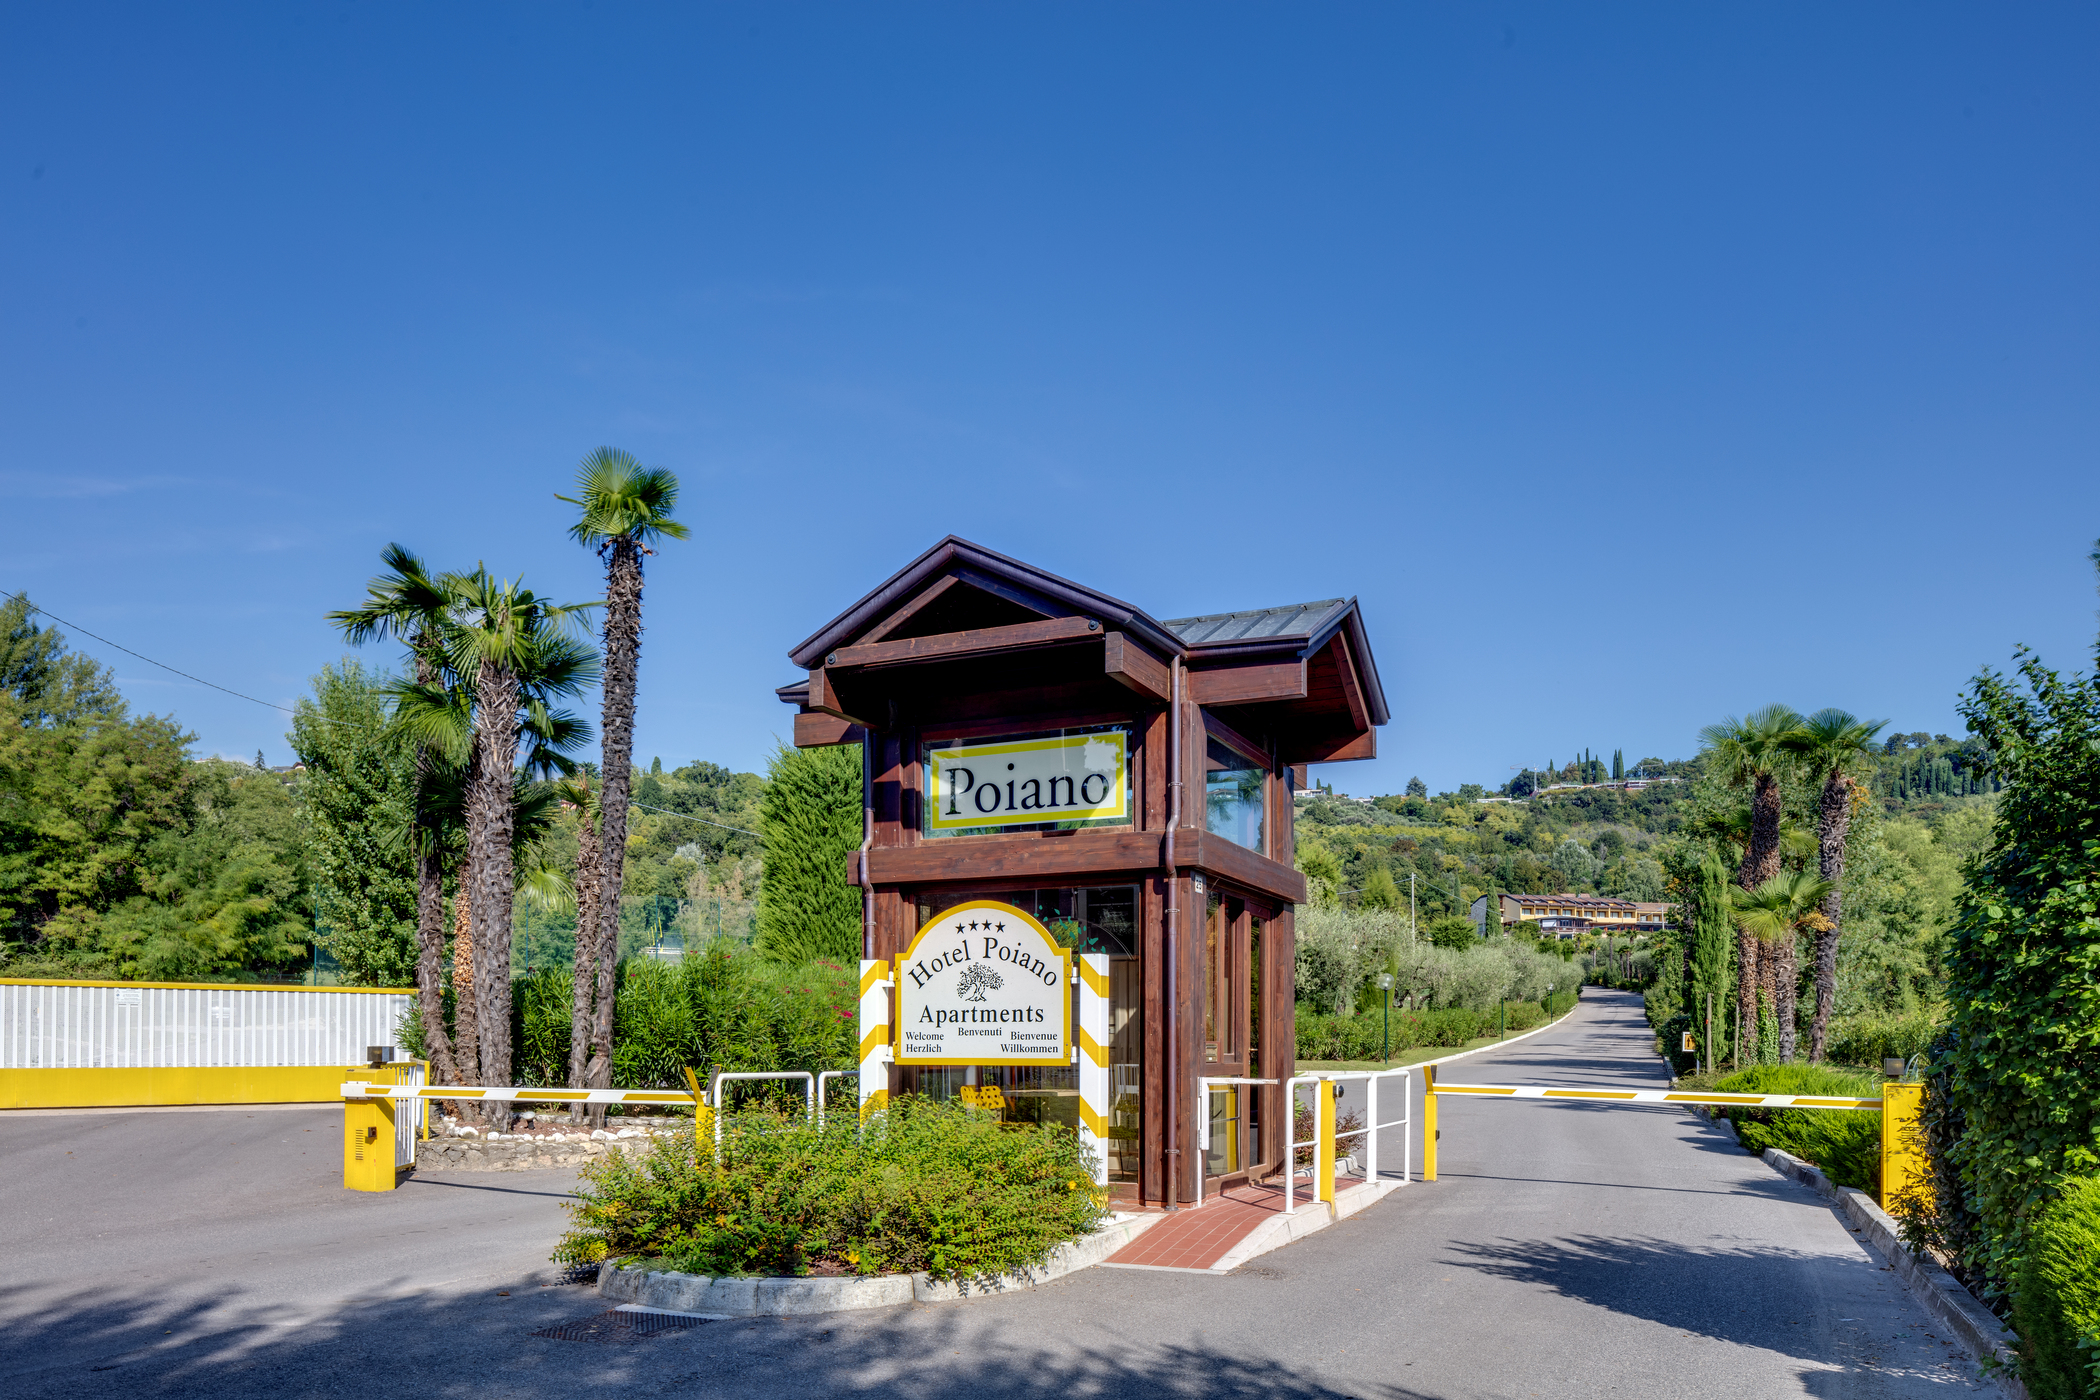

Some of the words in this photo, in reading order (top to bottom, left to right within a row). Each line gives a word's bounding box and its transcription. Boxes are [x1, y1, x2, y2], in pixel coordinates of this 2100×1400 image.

[945, 762, 1110, 815] Poiano
[908, 939, 972, 989] Hotel
[982, 937, 1058, 986] Poiano
[919, 1004, 1045, 1028] Apartments
[905, 1031, 944, 1041] Welcome
[957, 1027, 1003, 1037] Benvenuti
[1010, 1031, 1058, 1041] Bienvenue
[905, 1044, 943, 1053] Herzlich
[1000, 1044, 1059, 1053] Willkommen
